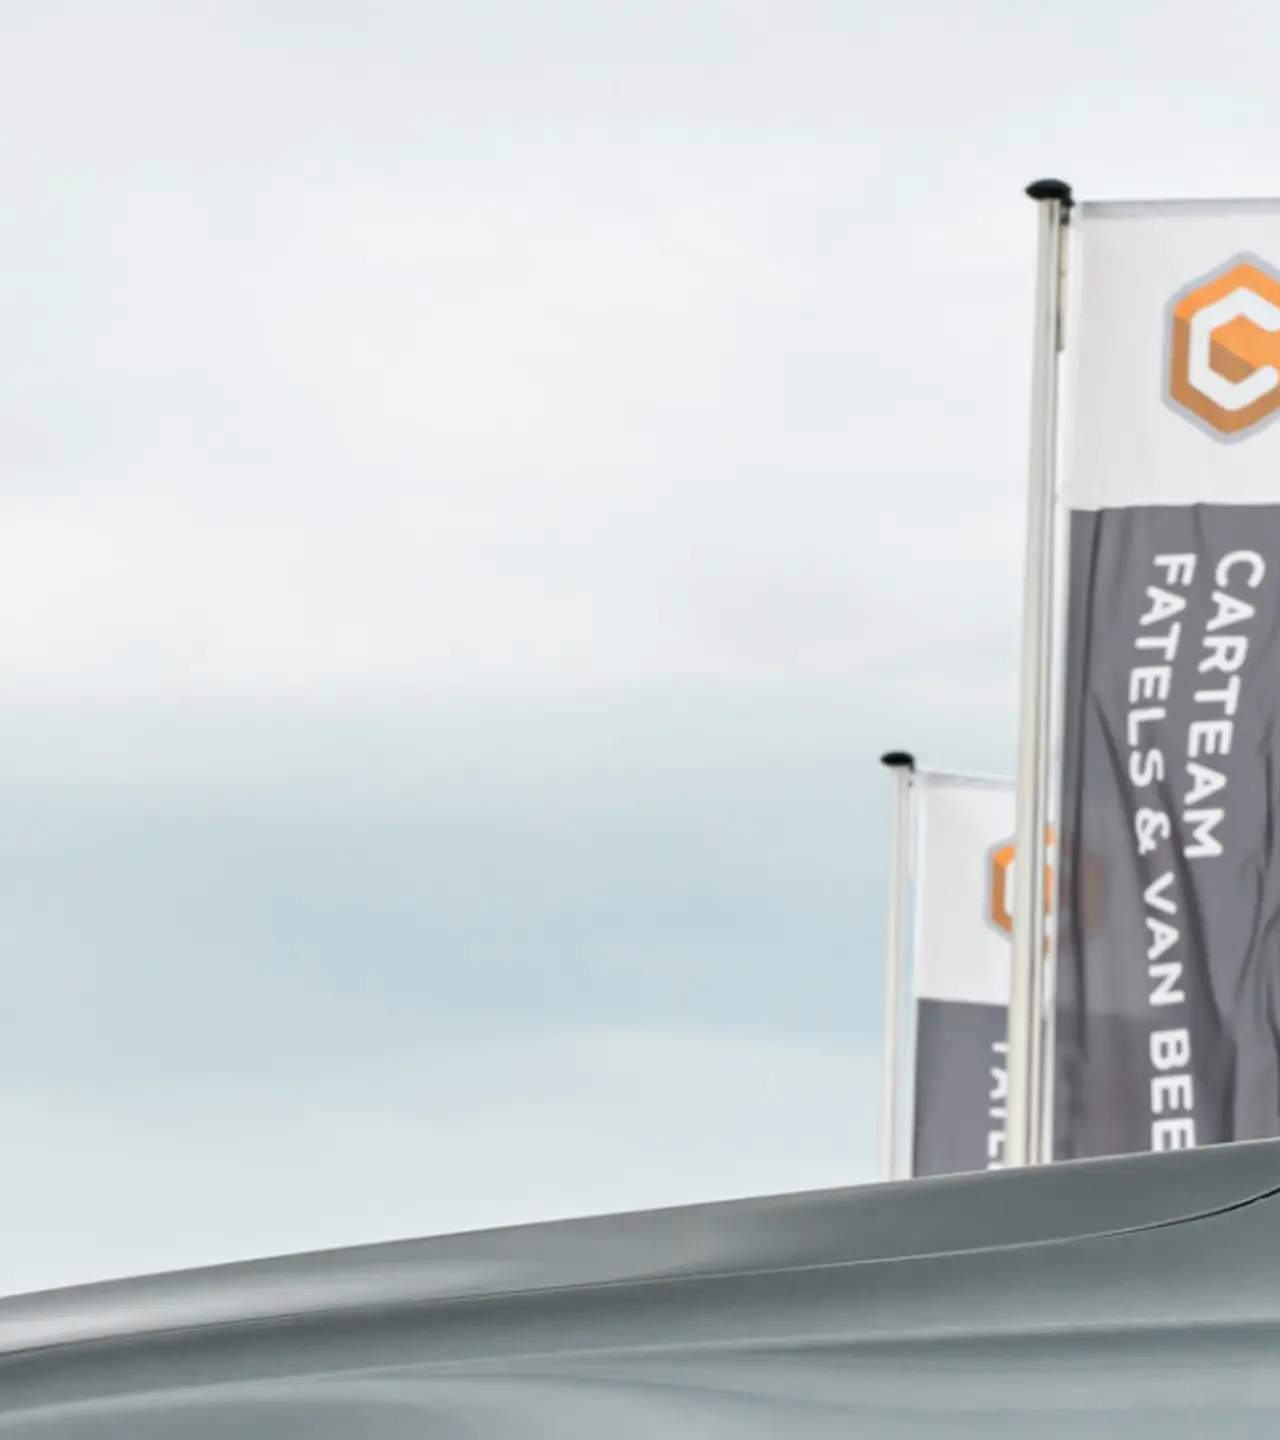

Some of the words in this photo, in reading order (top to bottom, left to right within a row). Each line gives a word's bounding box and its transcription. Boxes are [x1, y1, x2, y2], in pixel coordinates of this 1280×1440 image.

[1126, 552, 1198, 788] FATELS
[1182, 549, 1267, 859] CARTEAM
[1134, 807, 1171, 855] &
[1143, 871, 1186, 1006] VAN
